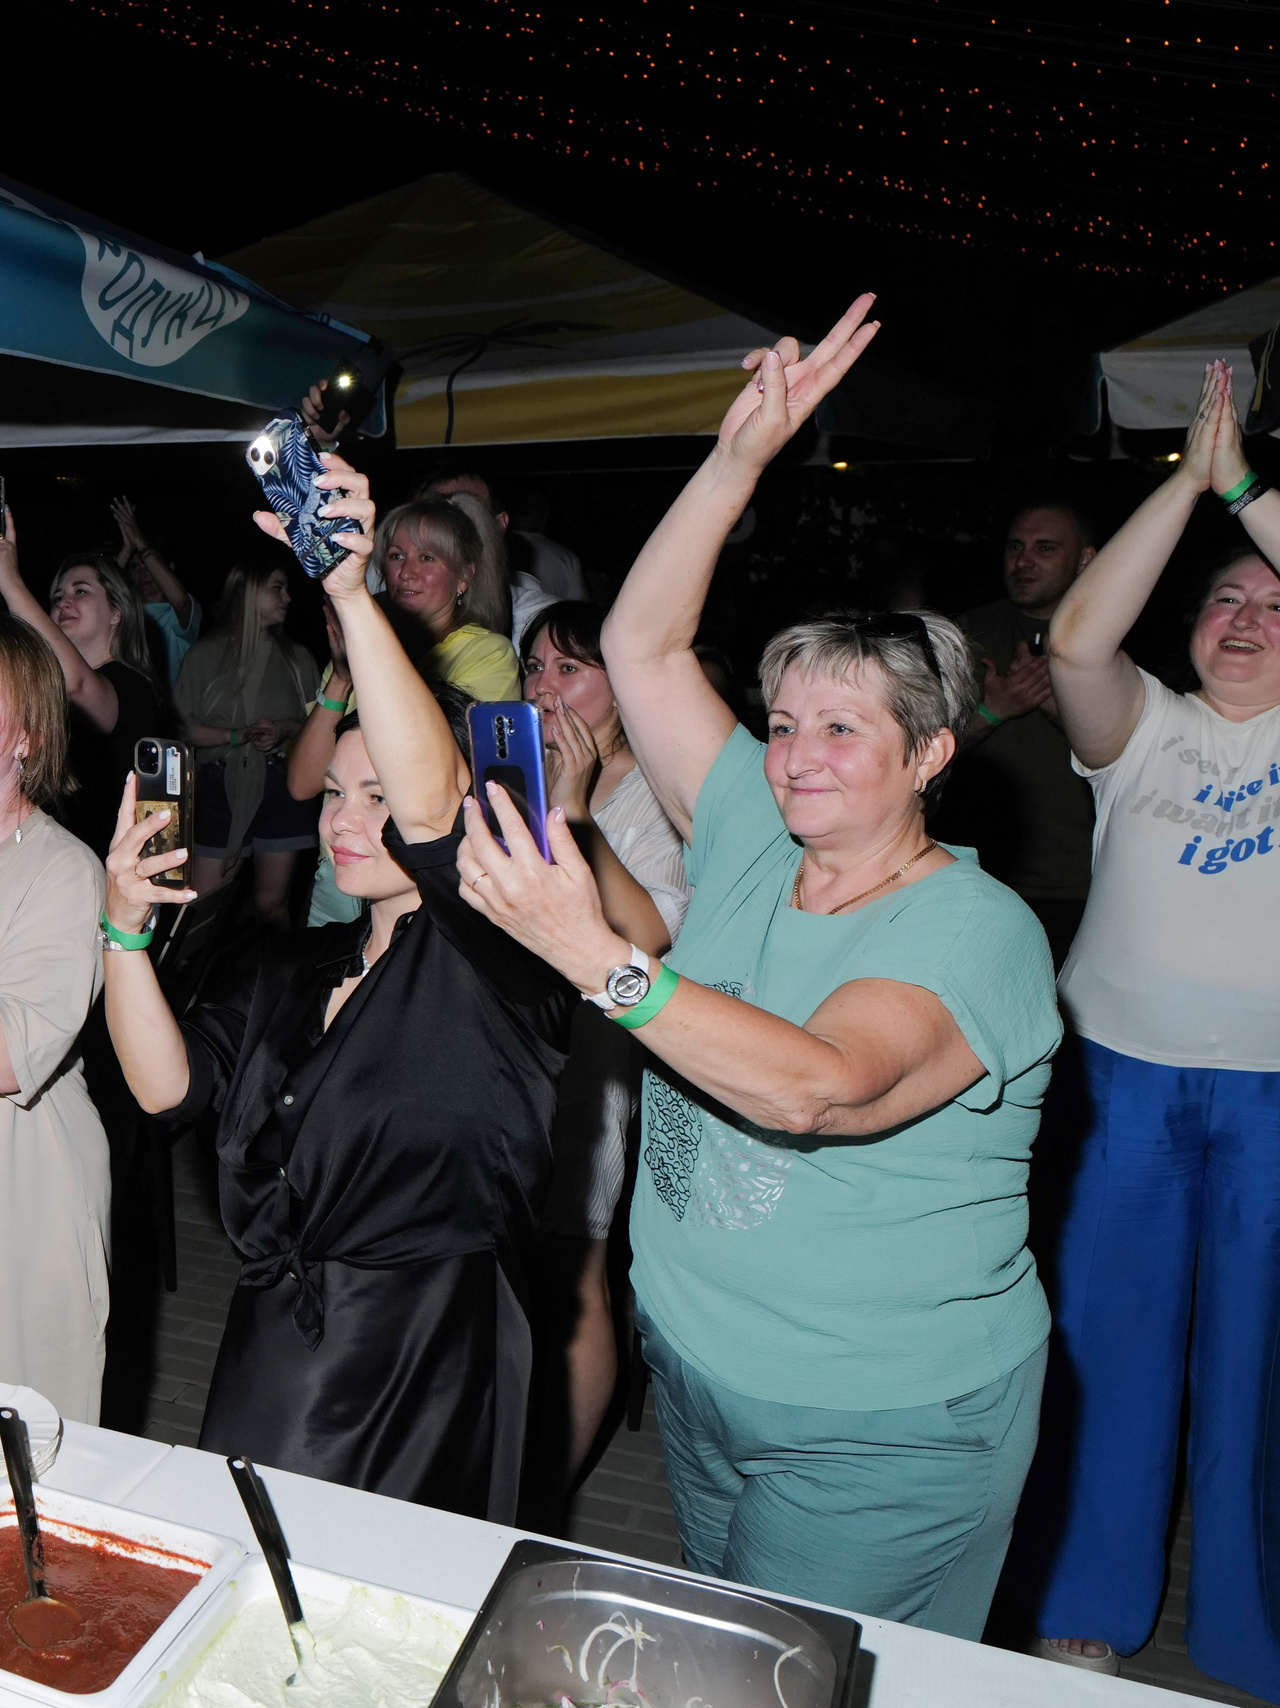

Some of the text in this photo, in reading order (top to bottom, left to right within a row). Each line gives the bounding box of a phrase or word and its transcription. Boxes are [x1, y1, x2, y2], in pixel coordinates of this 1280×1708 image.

[1130, 789, 1159, 814] i
[1192, 784, 1213, 804] i
[1268, 763, 1280, 786] i
[1178, 826, 1274, 875] i got
